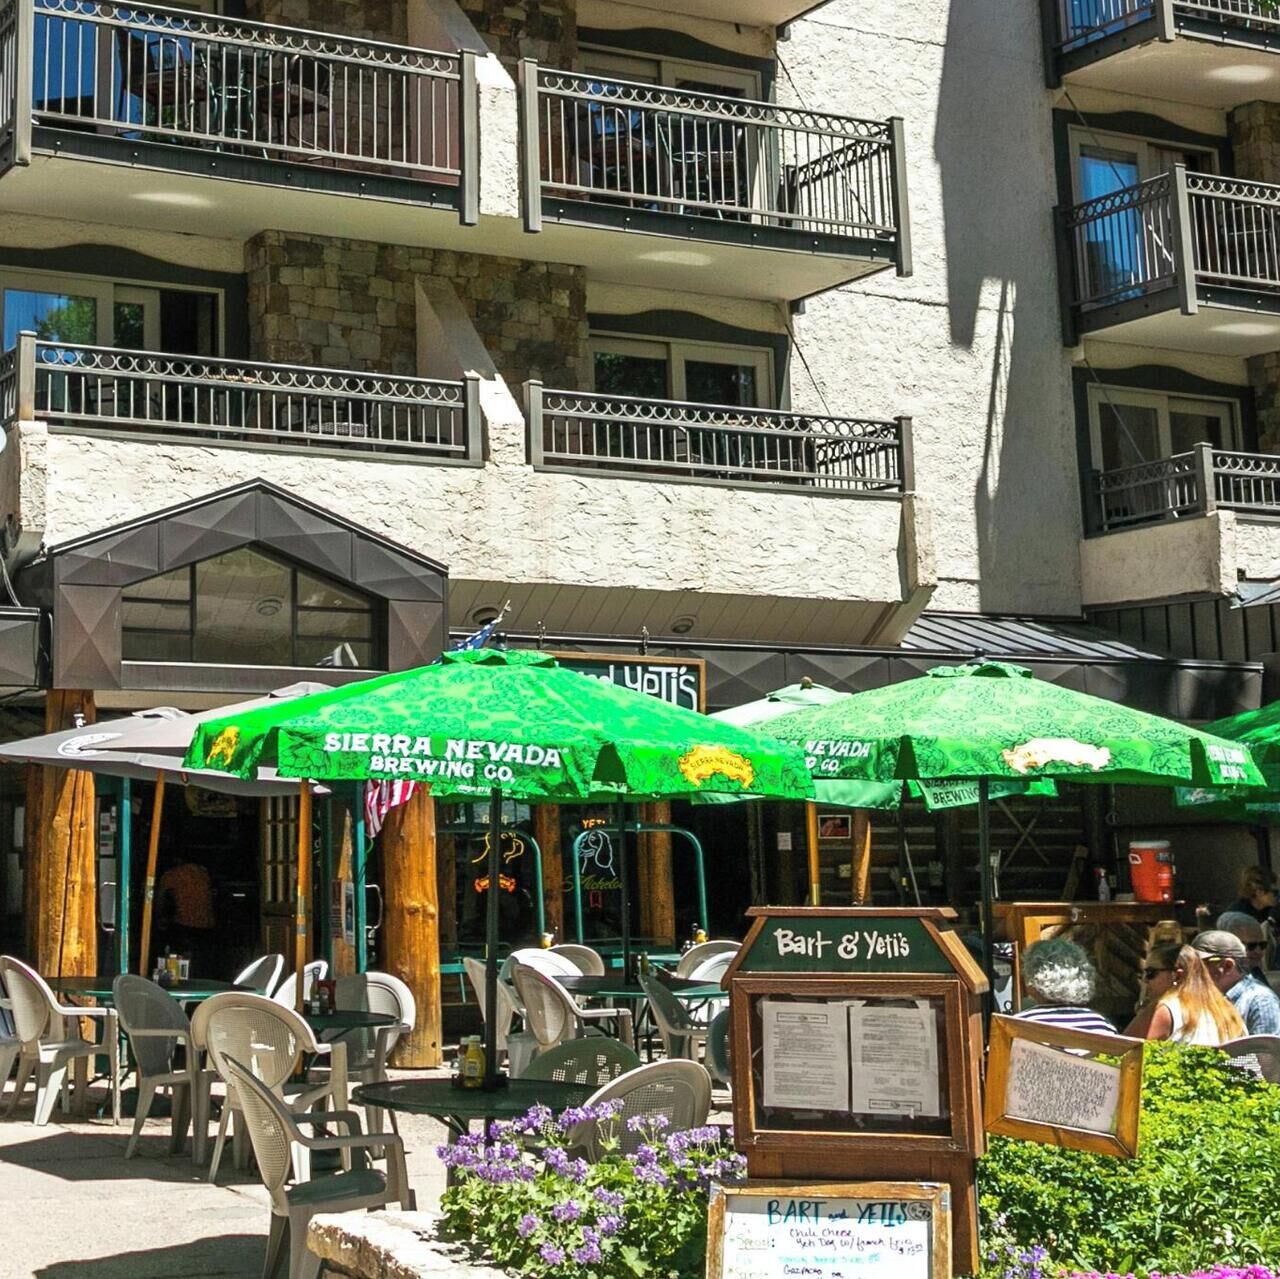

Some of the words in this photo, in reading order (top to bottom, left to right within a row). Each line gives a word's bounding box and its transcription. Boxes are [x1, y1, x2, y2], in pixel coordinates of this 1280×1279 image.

[323, 731, 432, 756] SIERRA
[445, 738, 565, 769] NEVADA
[689, 756, 714, 769] SIERRA
[714, 756, 744, 771] NEVADA
[370, 755, 475, 779] BREWING
[484, 767, 516, 784] CO.
[773, 927, 833, 959] Bart
[837, 931, 860, 960] &
[863, 930, 910, 960] Yeti's
[767, 1199, 827, 1226] BART
